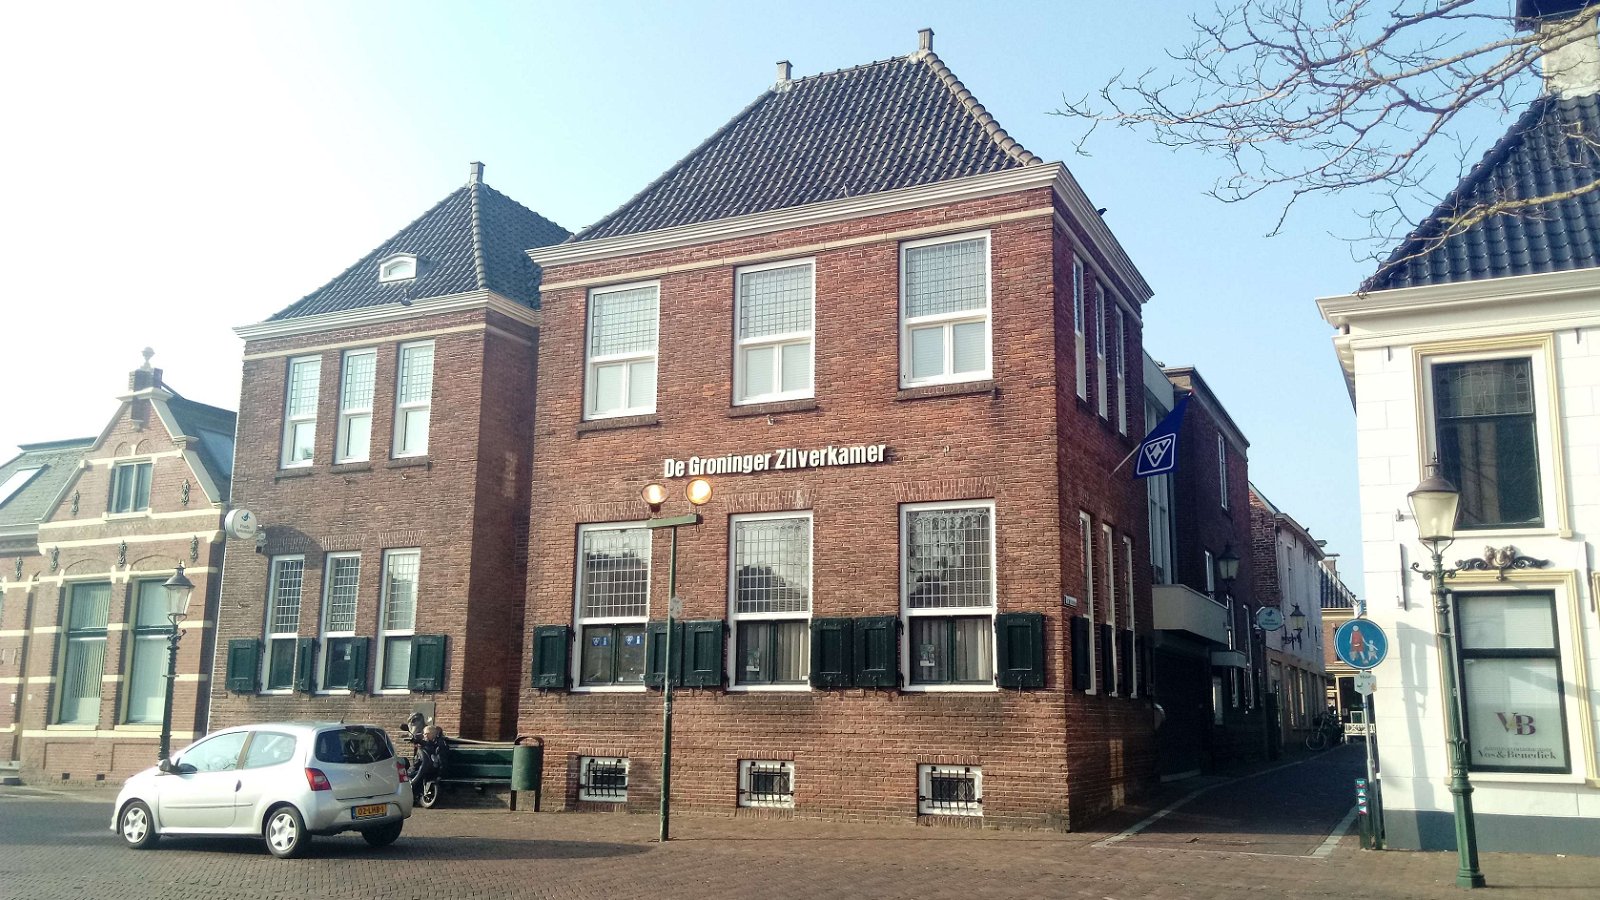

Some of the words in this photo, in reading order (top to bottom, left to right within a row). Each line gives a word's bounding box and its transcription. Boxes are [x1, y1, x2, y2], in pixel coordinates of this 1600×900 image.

[663, 458, 685, 478] De
[688, 453, 773, 475] Groninger
[774, 444, 887, 470] Zilverkamer
